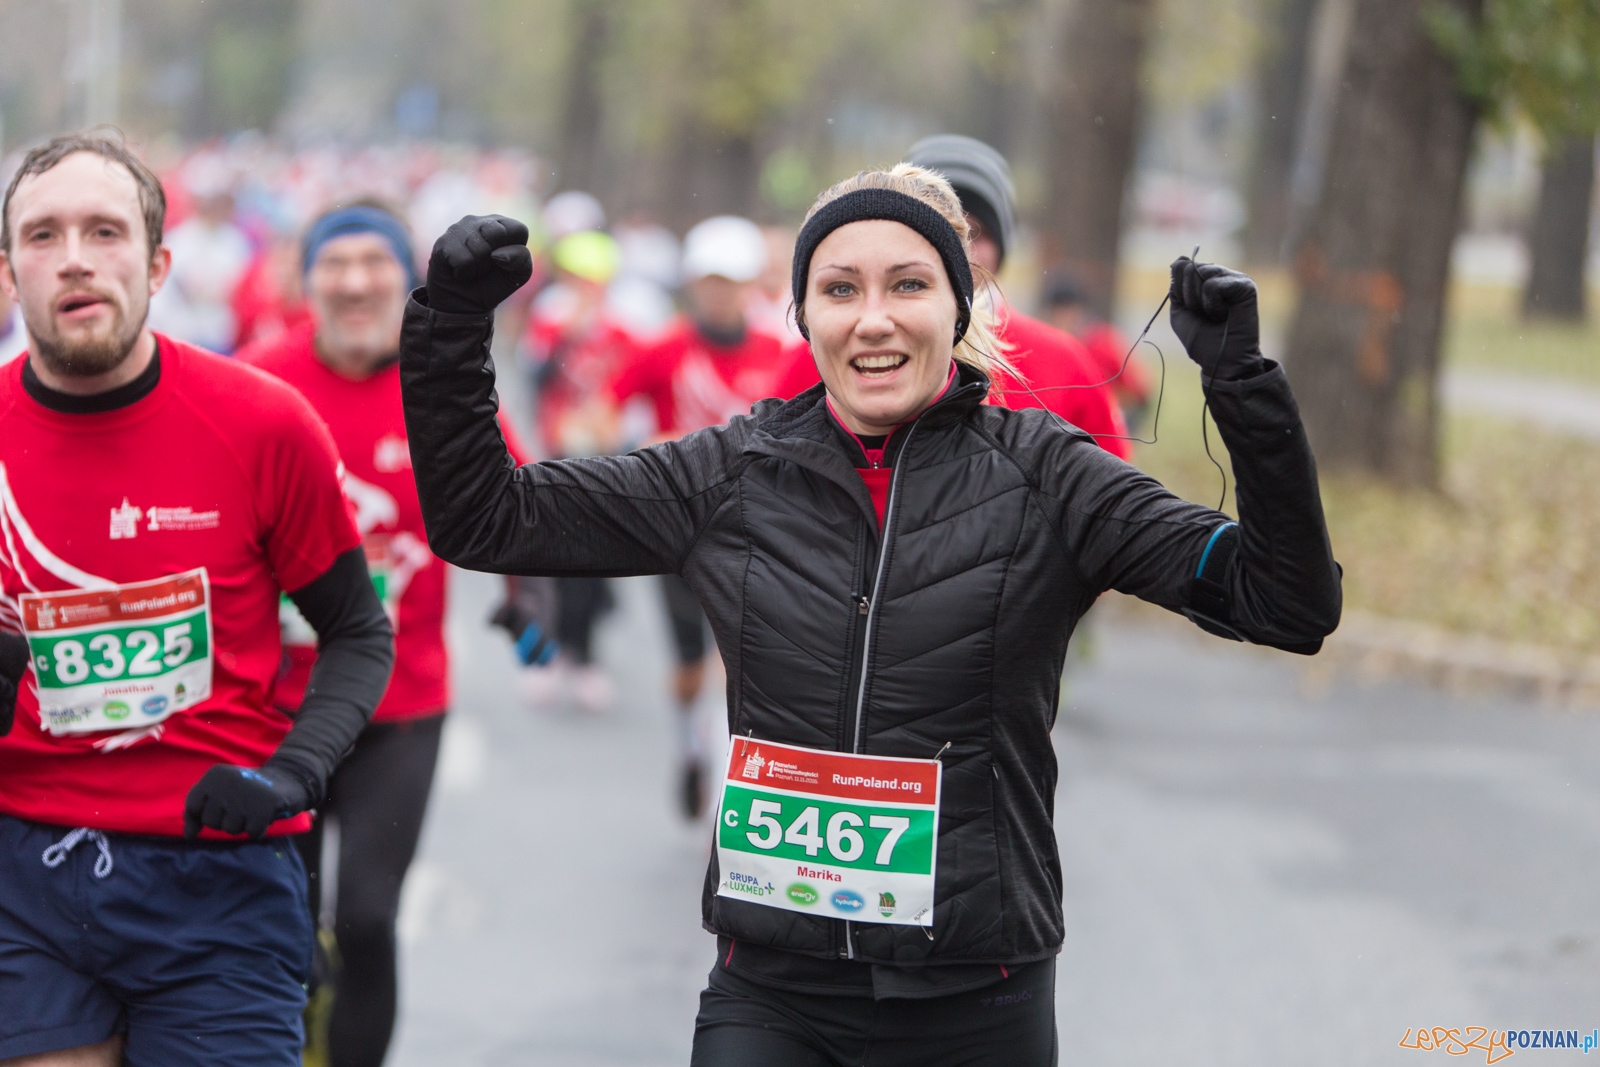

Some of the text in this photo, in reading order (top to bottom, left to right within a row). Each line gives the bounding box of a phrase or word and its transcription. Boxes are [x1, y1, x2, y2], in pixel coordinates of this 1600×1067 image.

[120, 590, 197, 614] RunPoland.org
[36, 622, 194, 684] C 8325
[102, 683, 155, 697] Jonathan
[766, 760, 774, 777] 1
[832, 773, 922, 794] RunPoland.org
[724, 798, 911, 866] C 5467
[729, 871, 759, 886] GRUPA
[797, 866, 842, 882] Marika
[729, 881, 764, 896] LUXMED
